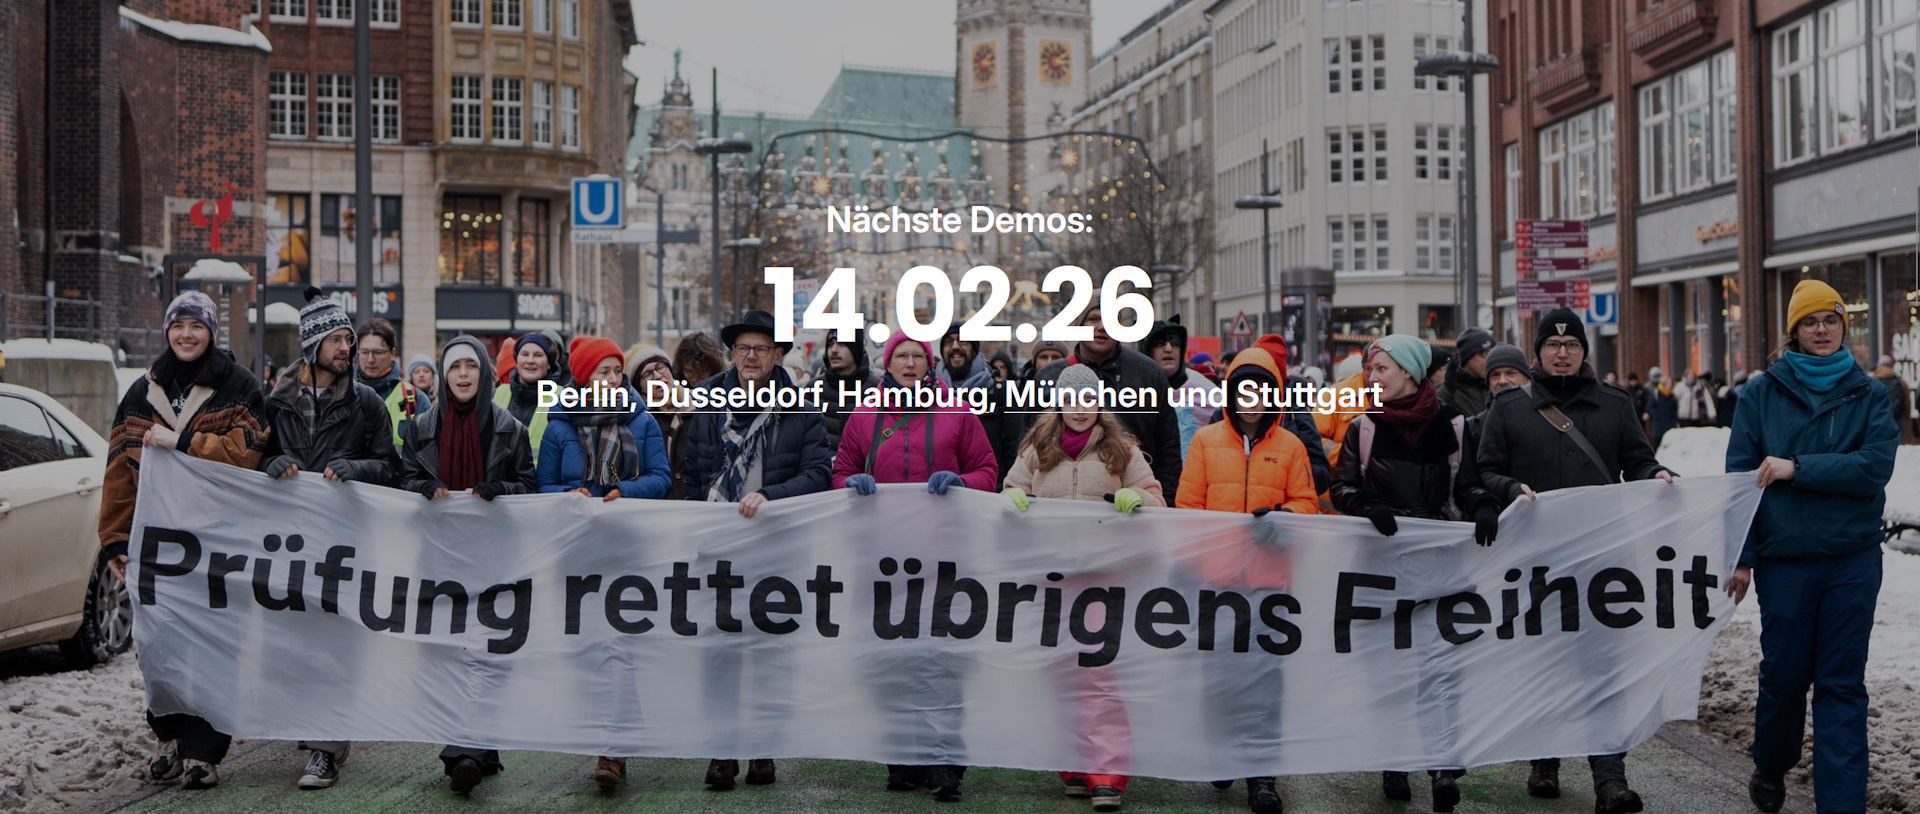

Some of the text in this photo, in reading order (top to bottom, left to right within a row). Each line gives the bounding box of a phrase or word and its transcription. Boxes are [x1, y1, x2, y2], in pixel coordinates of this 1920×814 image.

[580, 182, 615, 223] U
[574, 232, 613, 240] Rathaus
[329, 290, 389, 314] snis
[1589, 294, 1614, 322] U
[138, 526, 1719, 668] Prüfung rettet übrigens Freiheit
